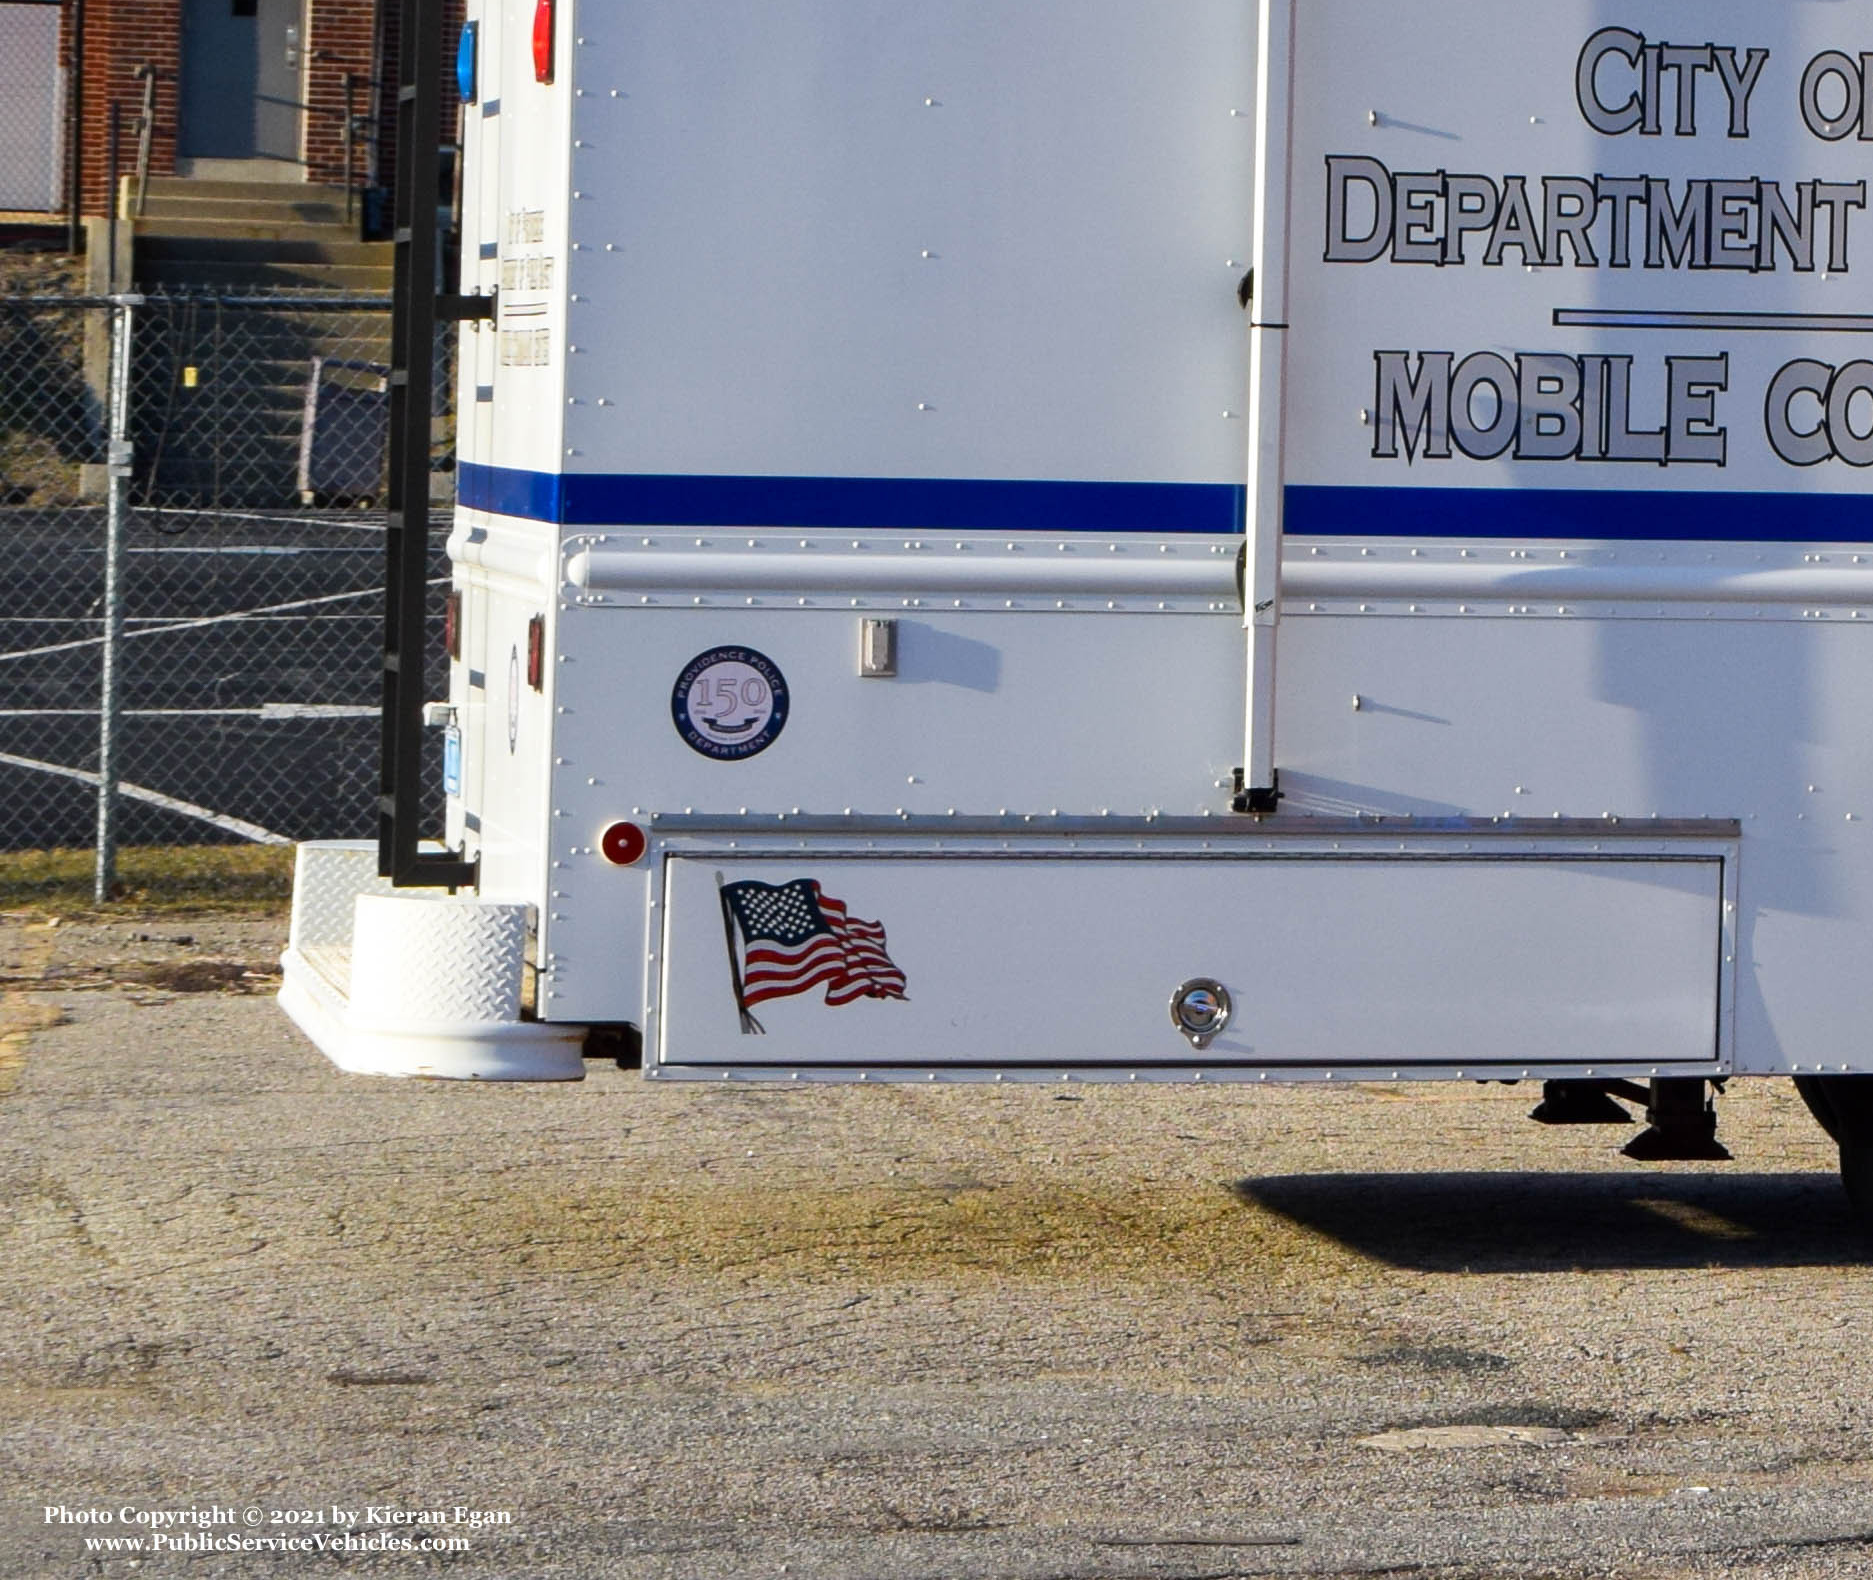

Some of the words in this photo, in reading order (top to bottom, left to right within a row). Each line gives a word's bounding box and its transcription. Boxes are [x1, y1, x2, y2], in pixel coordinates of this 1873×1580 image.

[1576, 26, 1768, 137] CITY
[1323, 154, 1867, 273] DEPARTMENT
[1371, 351, 1729, 467] MOBILE
[677, 651, 746, 698] PROVIDENCE
[750, 656, 783, 697] POLICE
[696, 677, 767, 718] 150
[687, 730, 770, 755] DEPARTMENT
